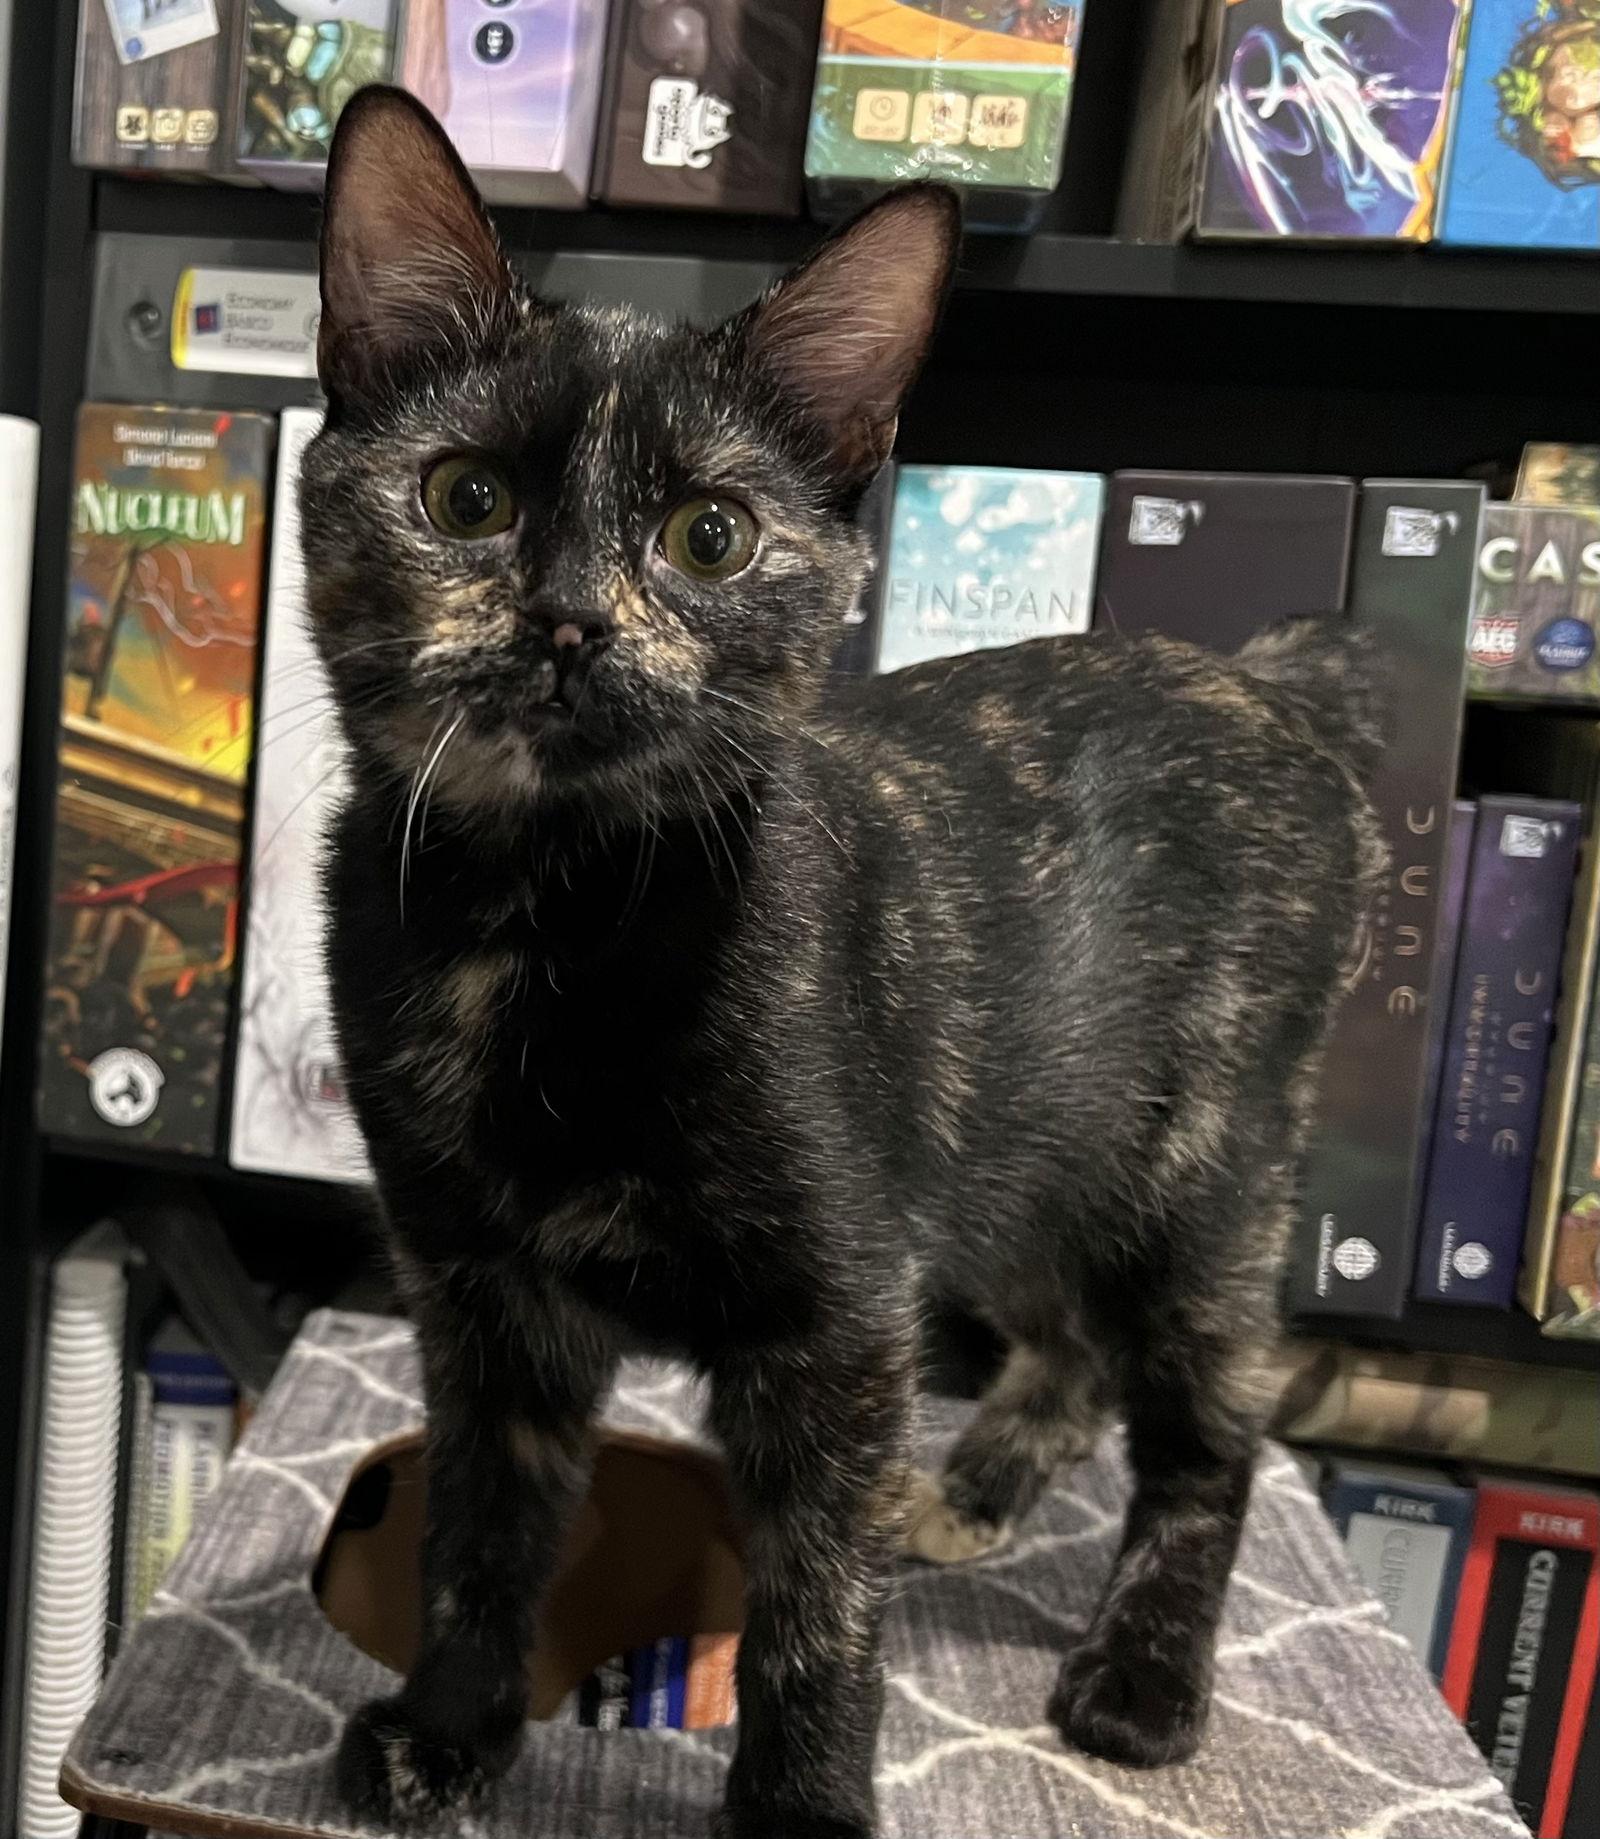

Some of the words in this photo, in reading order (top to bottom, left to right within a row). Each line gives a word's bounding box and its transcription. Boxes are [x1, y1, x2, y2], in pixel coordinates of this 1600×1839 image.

[889, 578, 1074, 623] FINSPAN
[1471, 625, 1517, 653] AEG
[1519, 1511, 1586, 1540] KIRK
[1506, 1548, 1558, 1692] CURRENT
